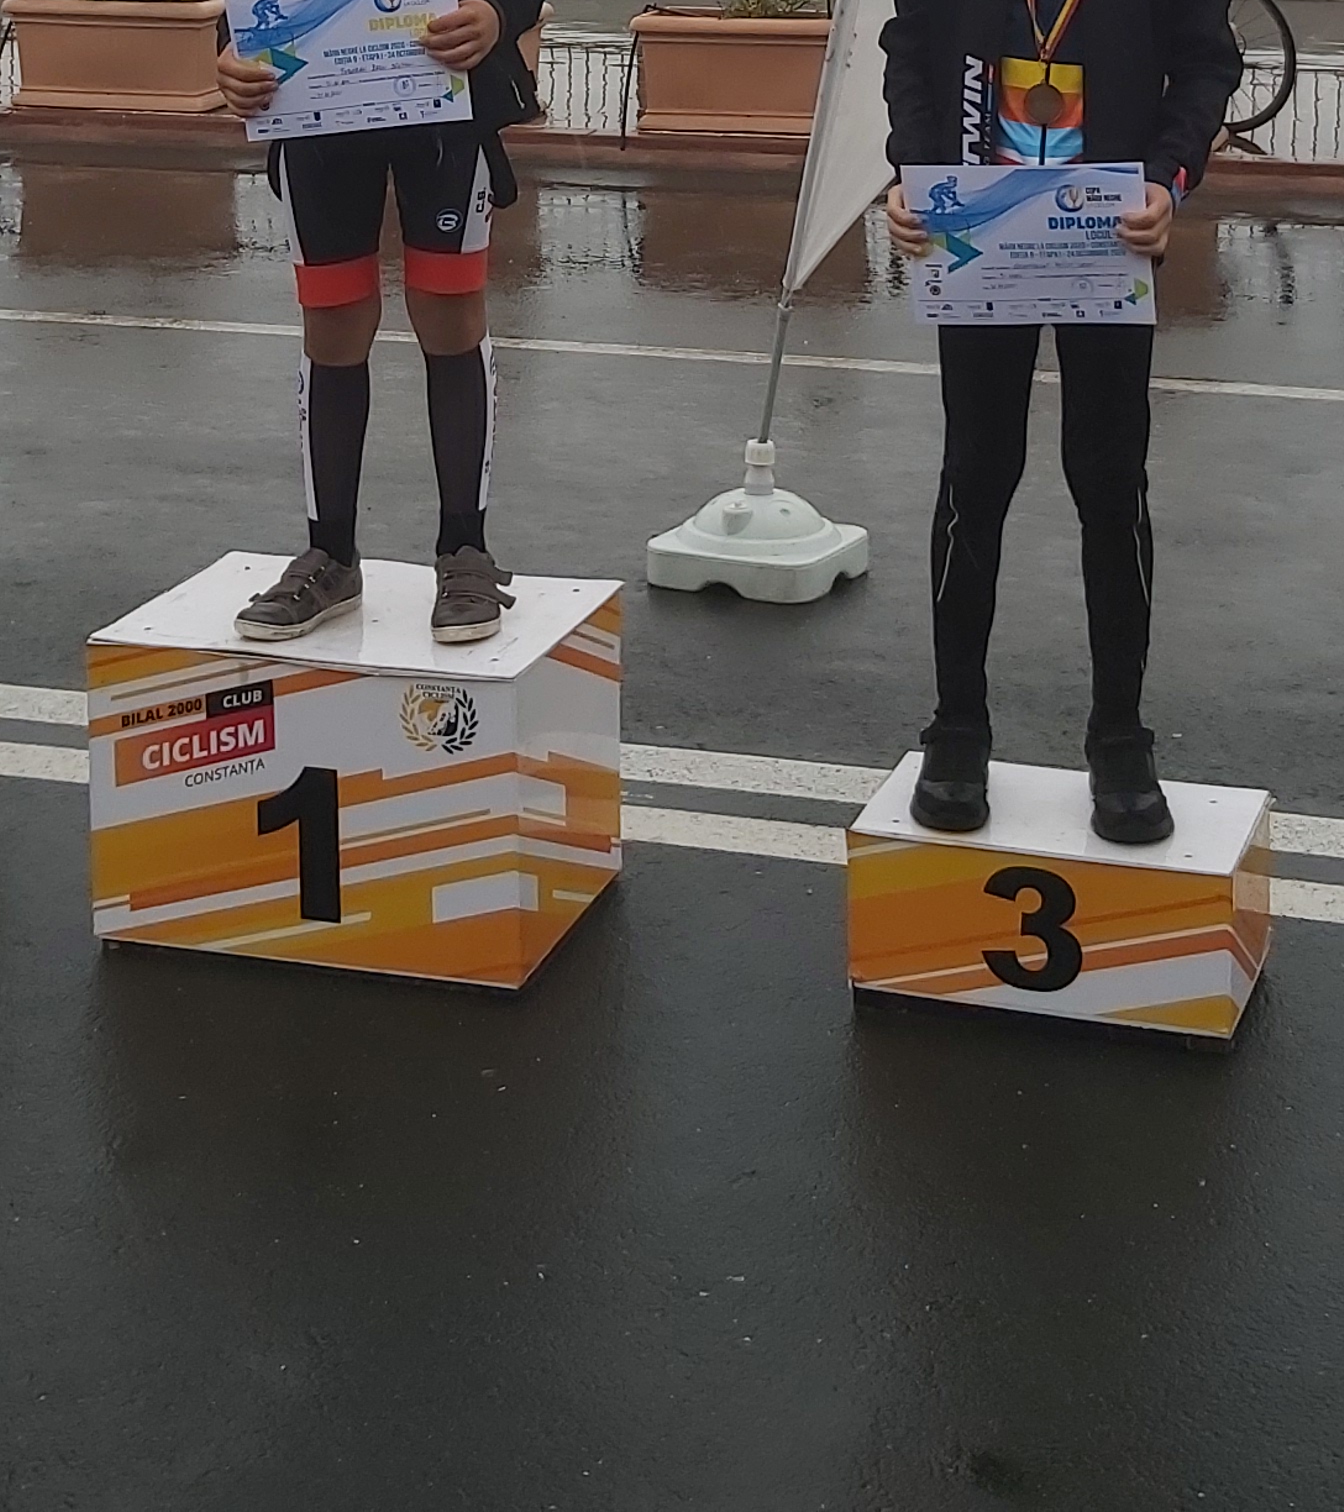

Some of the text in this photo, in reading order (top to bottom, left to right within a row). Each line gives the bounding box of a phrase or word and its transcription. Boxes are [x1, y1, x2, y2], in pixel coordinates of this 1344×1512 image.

[121, 690, 263, 728] BILAL 2000 CLUB
[141, 719, 265, 771] CICLISM
[257, 766, 342, 924] 1
[981, 865, 1084, 993] 3
